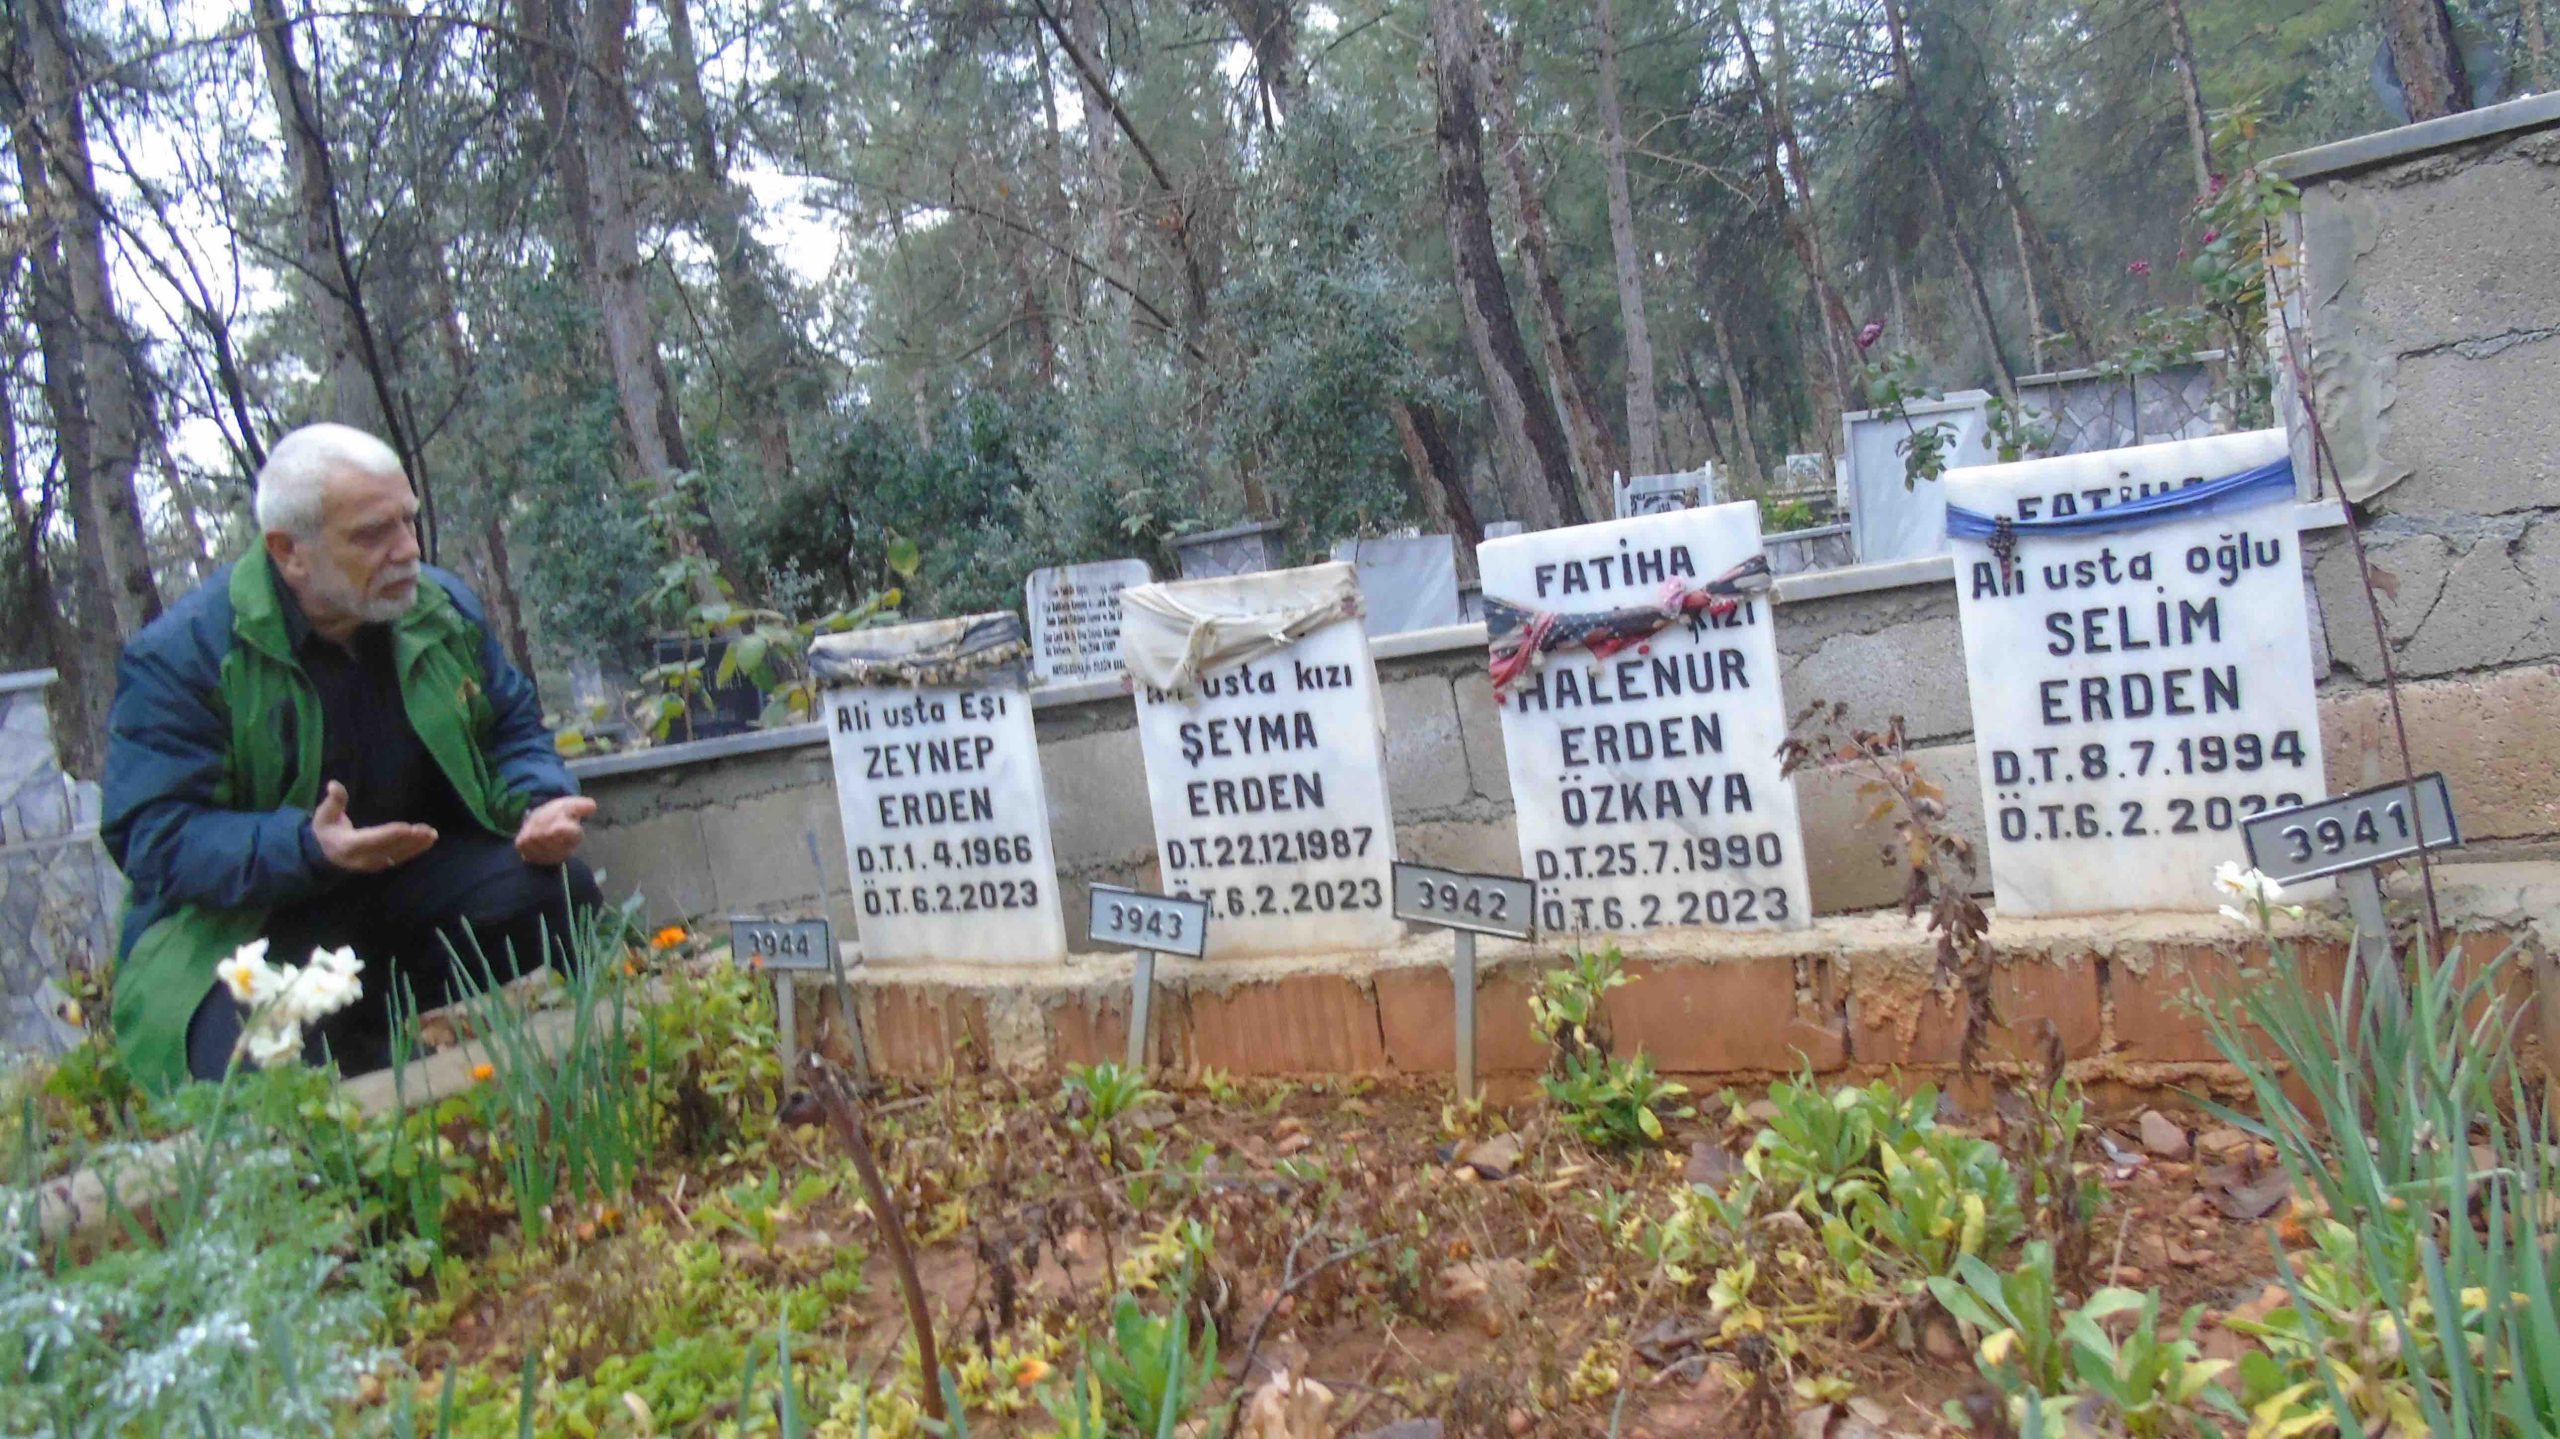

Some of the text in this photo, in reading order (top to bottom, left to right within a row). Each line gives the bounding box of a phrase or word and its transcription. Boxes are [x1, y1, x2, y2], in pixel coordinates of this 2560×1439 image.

[1534, 538, 1696, 598] FATİHA
[2043, 547, 2153, 591] usta
[2186, 531, 2281, 588] oğlu
[2045, 585, 2221, 657] SELİM
[1202, 663, 1276, 699] usta
[1294, 660, 1353, 691] kızı
[1517, 649, 1750, 713] HALENUR
[2039, 665, 2240, 726] ERDEN
[838, 700, 871, 733] Ali
[884, 695, 946, 728] usta
[1179, 711, 1318, 768] ŞEYMA
[1559, 712, 1723, 768] ERDEN
[863, 736, 995, 780] ZEYNEP
[1992, 729, 2306, 787] D.T.8.7.1994
[878, 787, 994, 829] ERDEN
[1186, 771, 1325, 817] ERDEN
[1558, 772, 1753, 828] ÖZKAYA
[1535, 831, 1783, 882] D.T.25.7.1990
[2280, 800, 2409, 864] 3941
[863, 878, 1039, 916] Ö.T.6.2.2023
[1109, 901, 1184, 940] 3943
[1417, 877, 1508, 921] 3942
[748, 929, 811, 958] 3944
